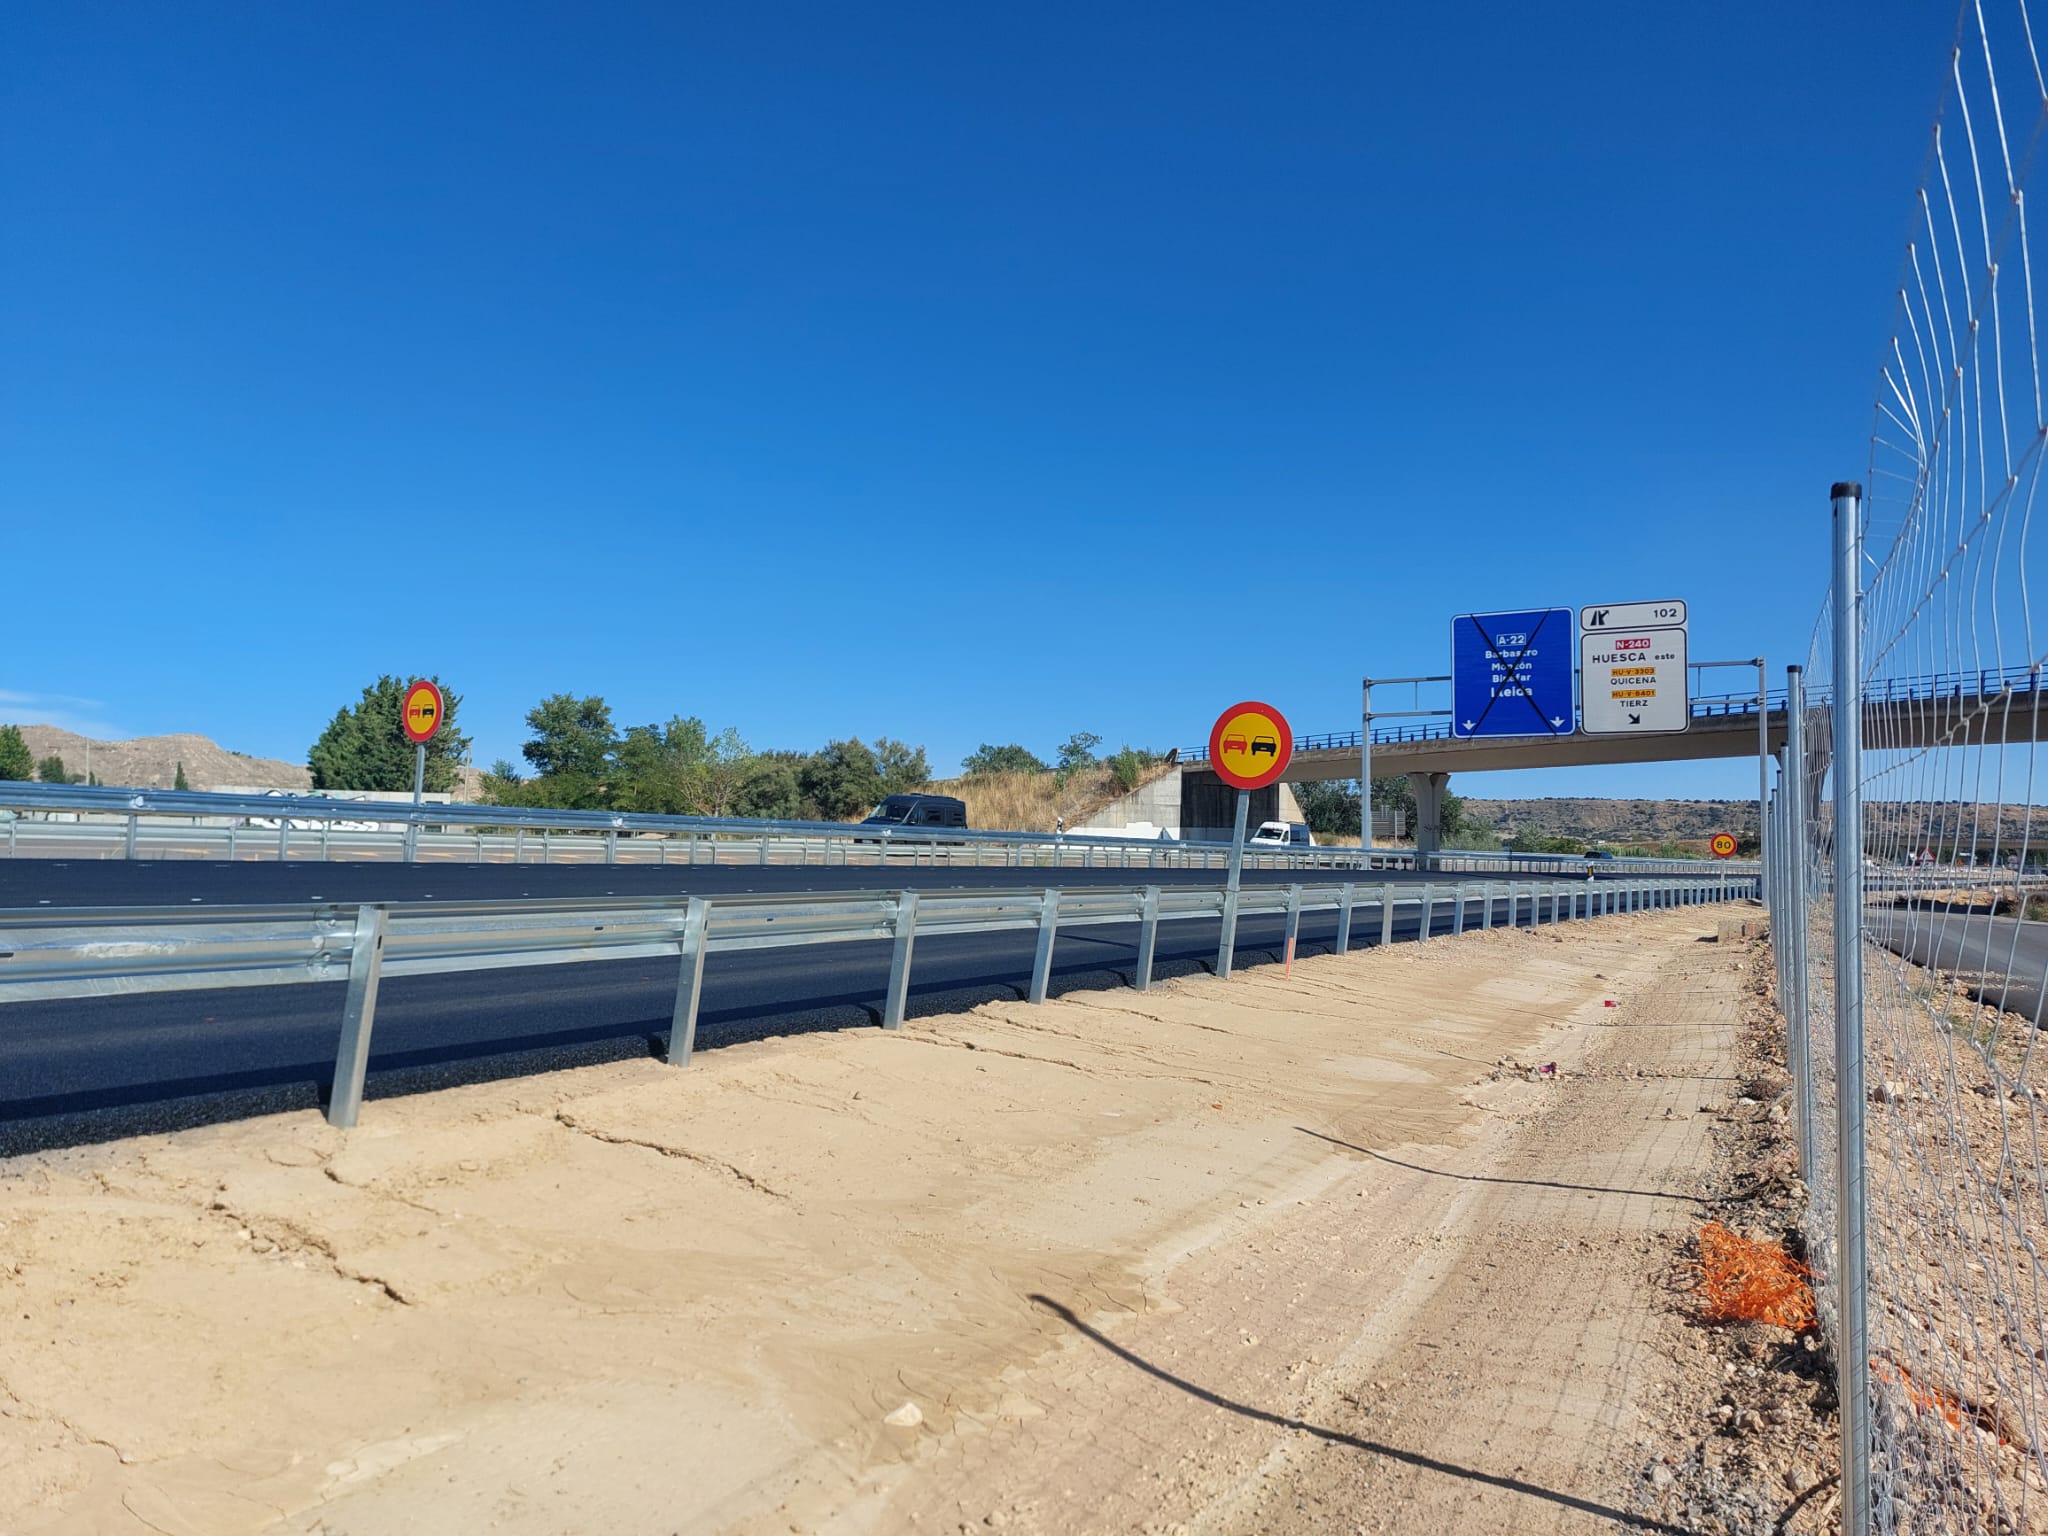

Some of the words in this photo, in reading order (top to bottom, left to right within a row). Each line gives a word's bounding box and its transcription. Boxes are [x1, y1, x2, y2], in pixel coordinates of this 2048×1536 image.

[1653, 608, 1677, 618] 102
[1498, 635, 1525, 645] A-22
[1616, 639, 1650, 649] N-240
[1592, 652, 1646, 663] HUESCA
[1654, 653, 1675, 661] este
[1610, 677, 1656, 685] QUICENA
[1619, 699, 1648, 707] TIERZ
[1716, 840, 1731, 849] 80
